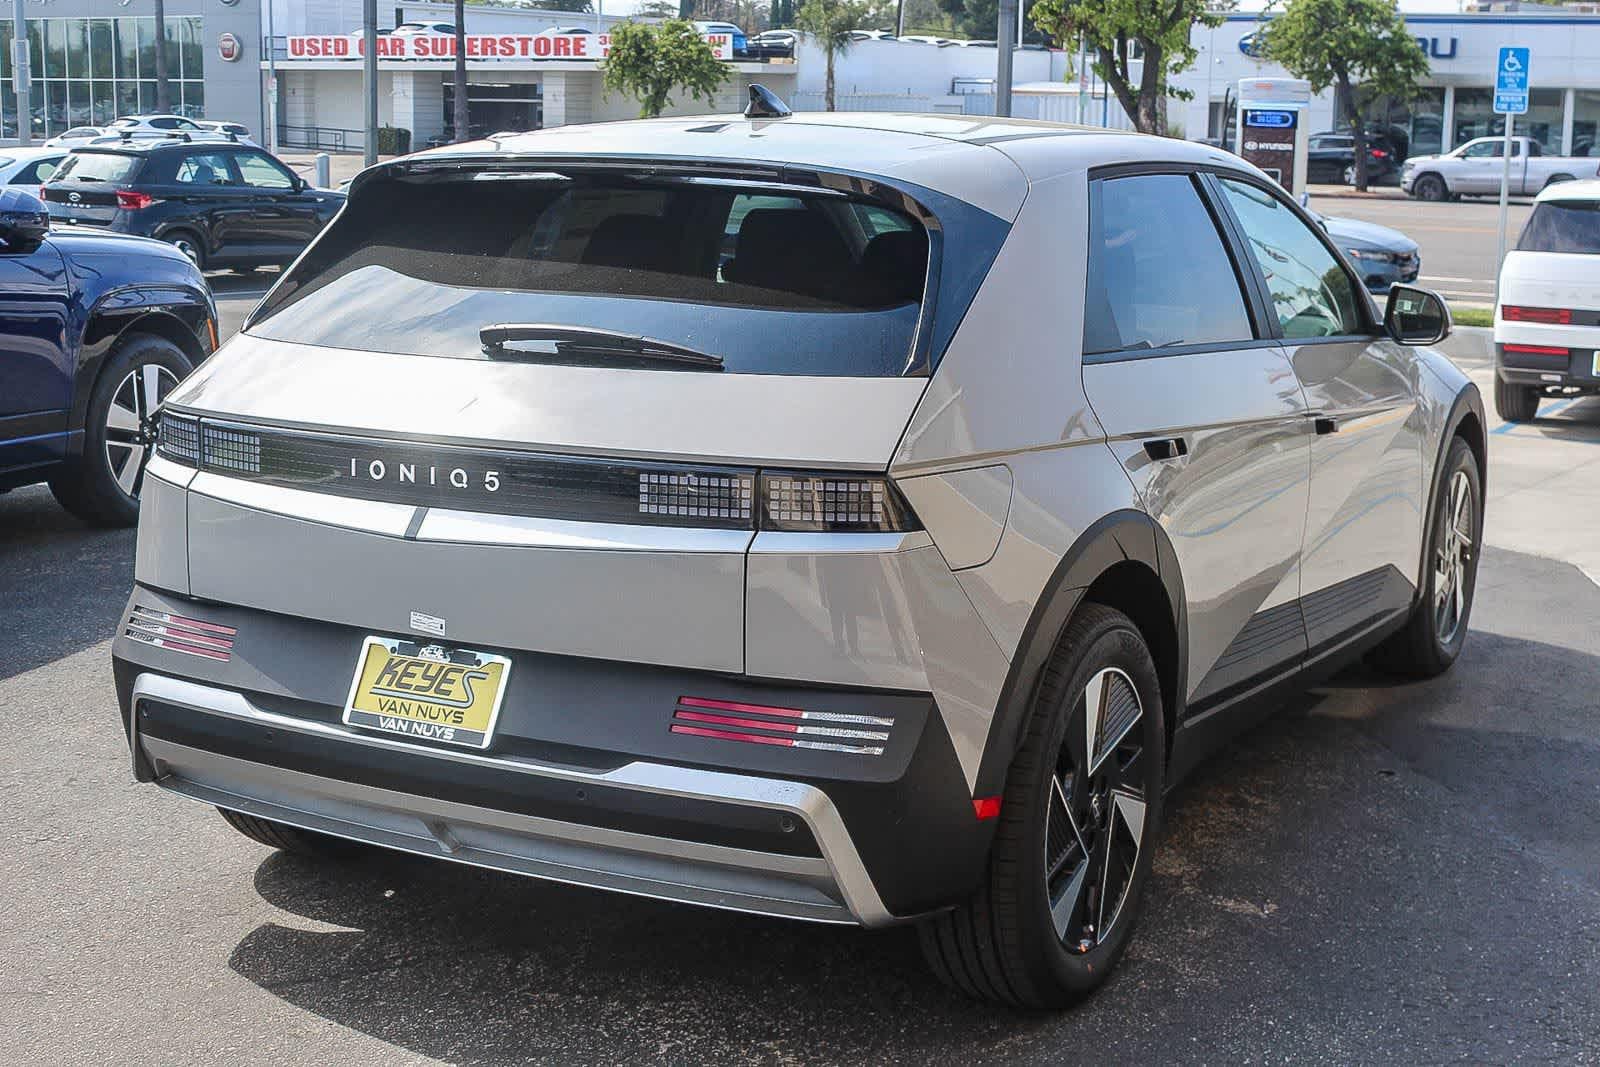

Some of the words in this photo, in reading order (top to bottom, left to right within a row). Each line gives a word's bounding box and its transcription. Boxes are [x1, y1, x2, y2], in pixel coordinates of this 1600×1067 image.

[290, 38, 349, 57] USED
[350, 457, 469, 489] IONIQ
[483, 471, 501, 492] 5
[369, 657, 489, 709] KEYES
[377, 697, 411, 716] VAN
[416, 704, 465, 724] NUYS
[378, 716, 409, 733] VAN
[411, 722, 456, 741] NUYS
